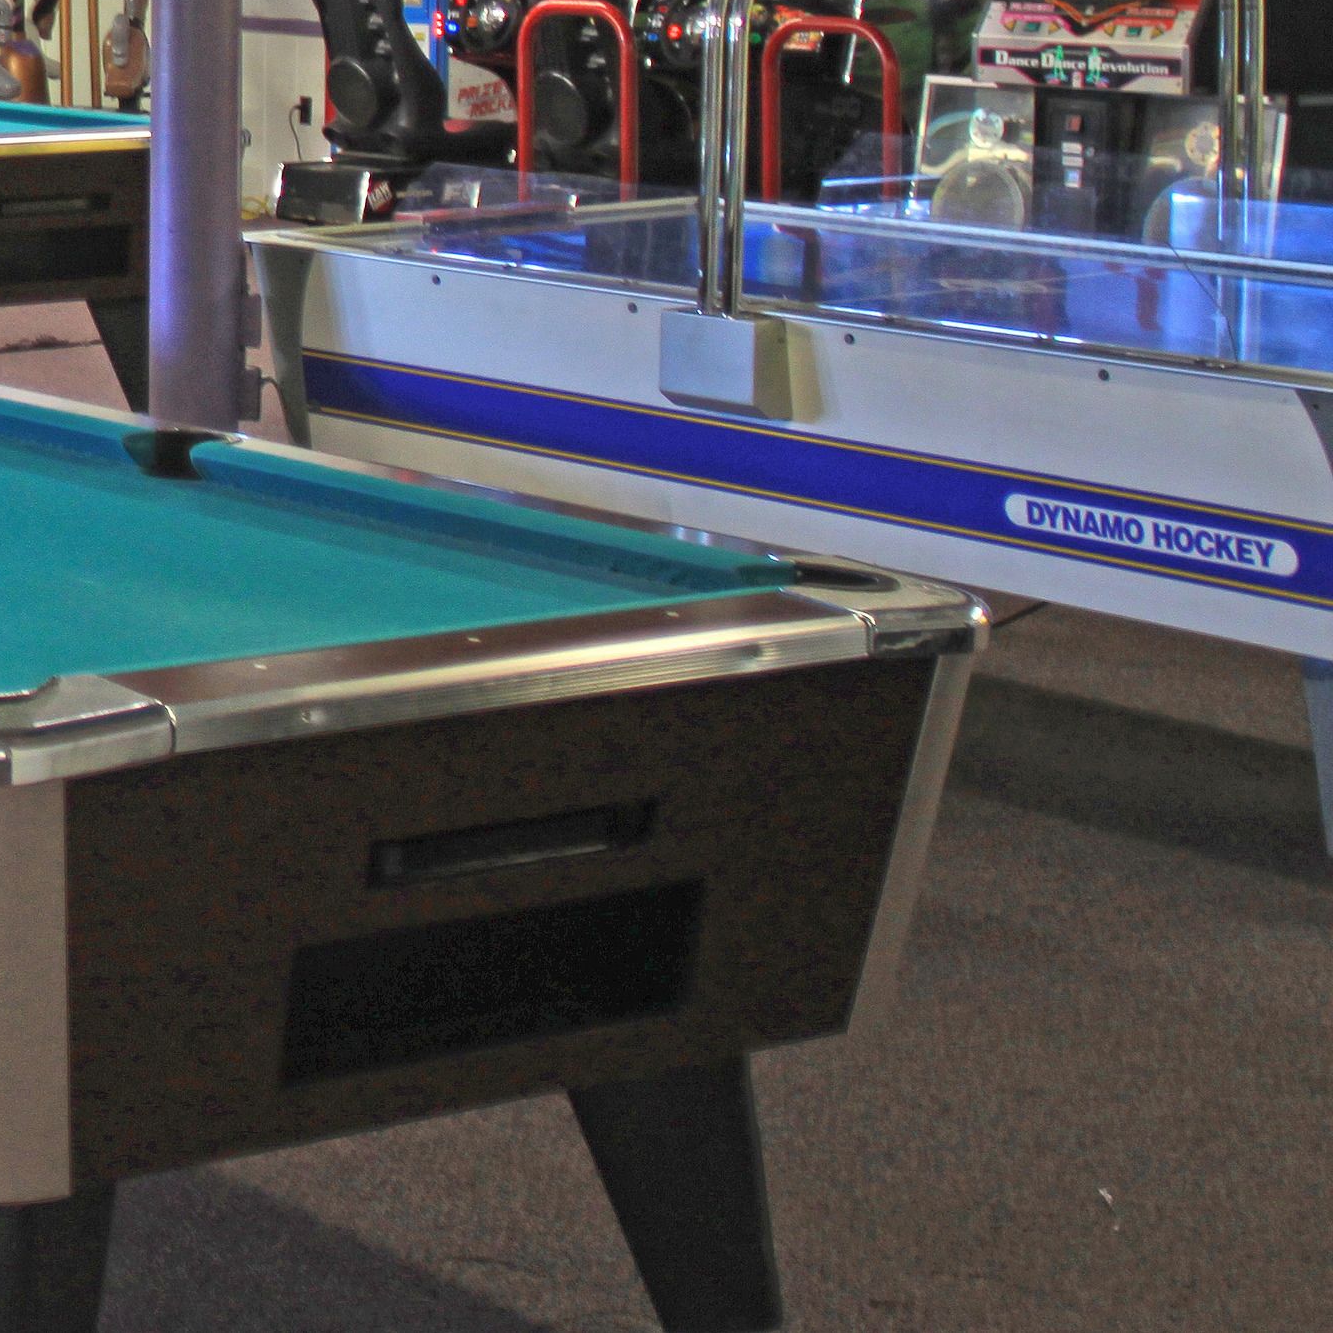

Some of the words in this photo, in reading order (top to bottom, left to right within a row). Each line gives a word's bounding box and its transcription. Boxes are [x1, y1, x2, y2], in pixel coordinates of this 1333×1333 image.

[995, 50, 1040, 67] Dance
[1041, 52, 1086, 69] Dance
[1088, 54, 1169, 75] Revolution
[1025, 499, 1145, 547] DYNAMO
[1151, 521, 1275, 568] HOCKEY
